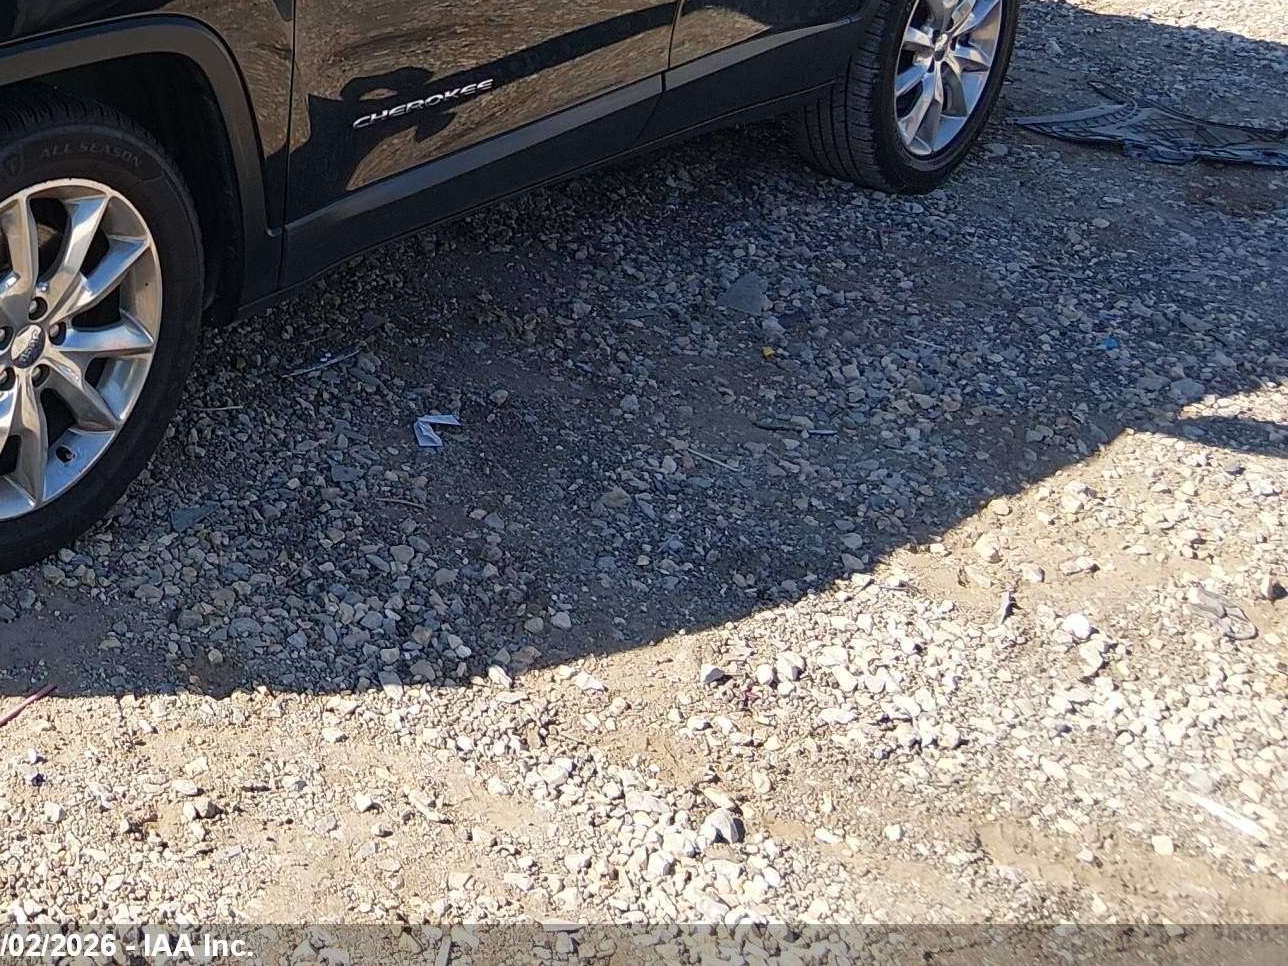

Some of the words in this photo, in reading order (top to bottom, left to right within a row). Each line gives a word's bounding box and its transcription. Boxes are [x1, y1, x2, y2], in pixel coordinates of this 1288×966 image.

[353, 78, 494, 130] CHEROKEE
[39, 143, 71, 160] ALL
[79, 142, 144, 167] SEASON
